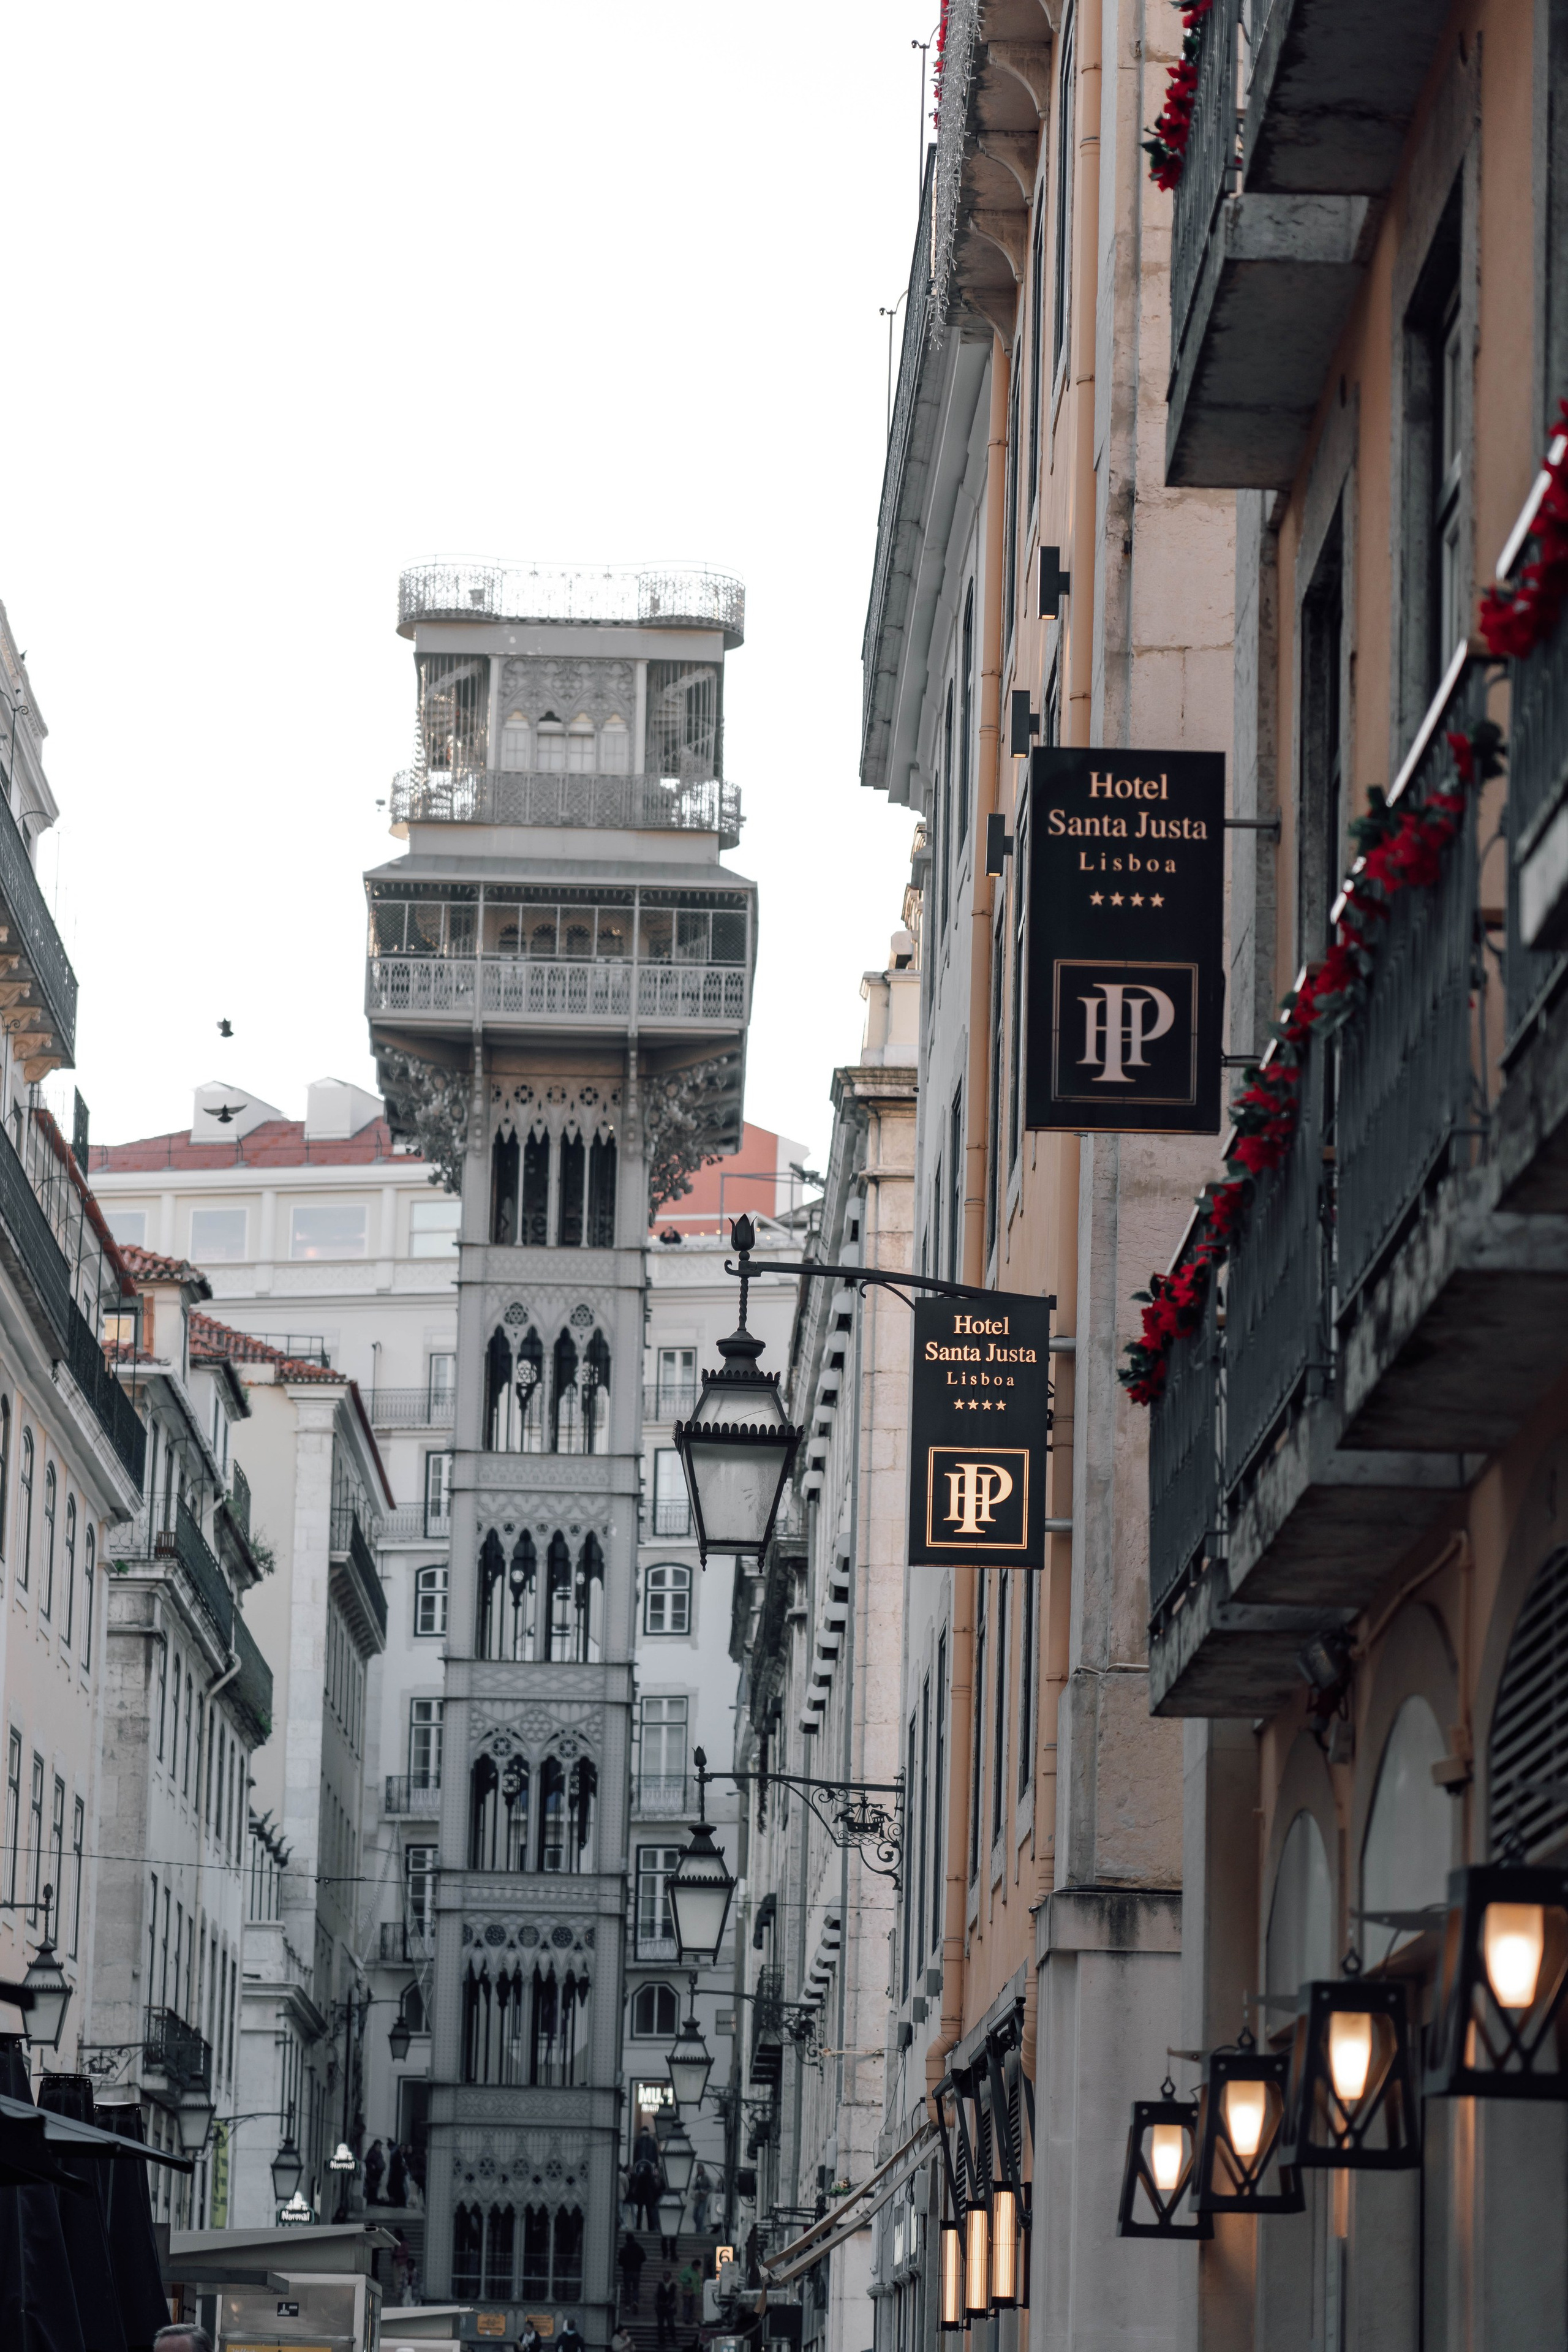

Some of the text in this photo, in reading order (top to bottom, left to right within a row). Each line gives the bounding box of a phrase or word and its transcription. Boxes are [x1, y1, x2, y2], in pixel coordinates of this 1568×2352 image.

[1089, 772, 1168, 800] Hotel
[1047, 809, 1208, 840] Santa Justa
[1079, 852, 1176, 873] Lisboa
[954, 1315, 1010, 1335] Hotel
[925, 1341, 1037, 1363] Santa Justa
[947, 1371, 1015, 1386] Lisboa
[330, 2160, 355, 2170] Normal
[281, 2210, 310, 2222] Normal
